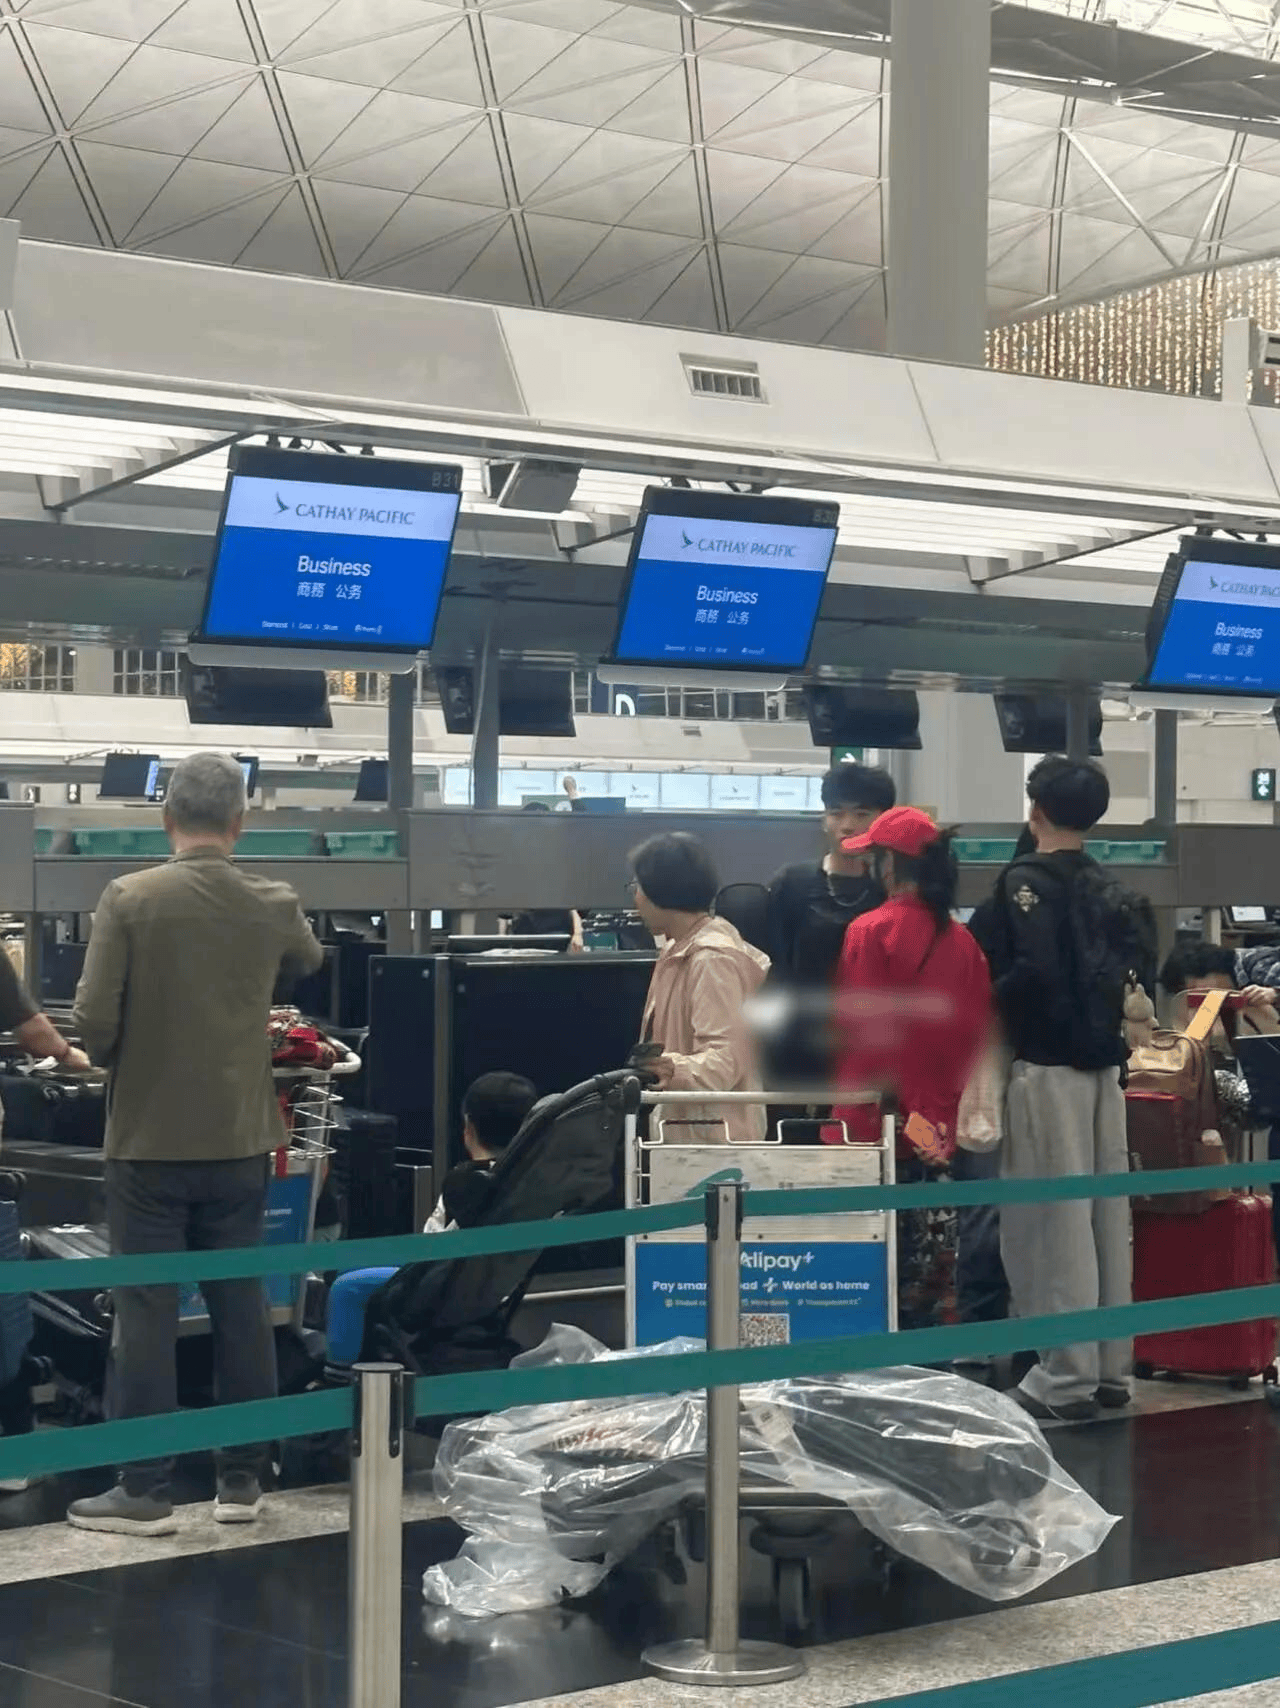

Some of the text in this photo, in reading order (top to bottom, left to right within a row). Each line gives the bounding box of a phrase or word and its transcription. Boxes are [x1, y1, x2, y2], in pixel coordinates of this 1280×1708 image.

[295, 503, 416, 525] CATHAY PACIFIC
[697, 538, 799, 558] CATHAY PACIFIC
[297, 556, 372, 577] Business
[296, 581, 362, 600] 商務 公务
[696, 585, 758, 605] Business
[1215, 622, 1263, 640] Business
[652, 1280, 870, 1293] Pay smar World as home
